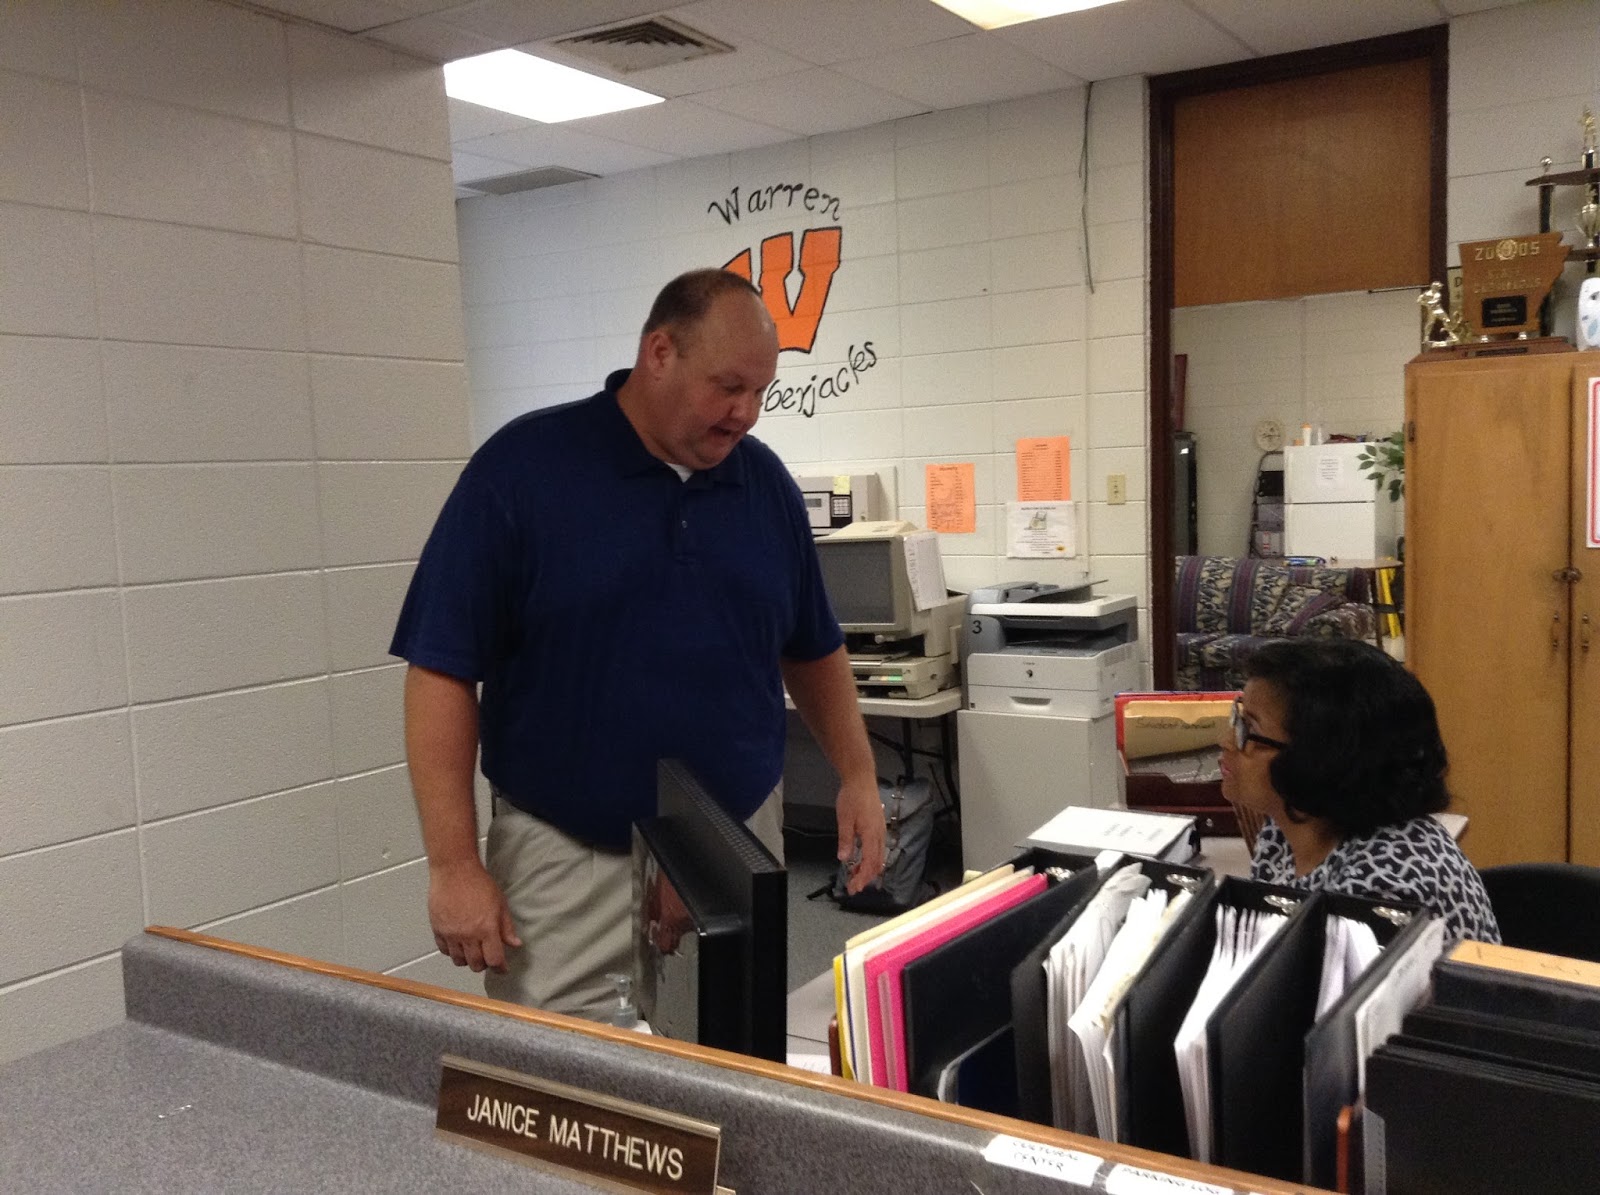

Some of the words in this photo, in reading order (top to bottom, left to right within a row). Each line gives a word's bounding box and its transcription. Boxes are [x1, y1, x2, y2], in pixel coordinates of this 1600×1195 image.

[708, 183, 840, 225] Warren
[763, 341, 877, 418] berjacks
[972, 620, 982, 634] 3
[467, 1094, 540, 1139] JANICE
[549, 1115, 684, 1181] MATTHEWS
